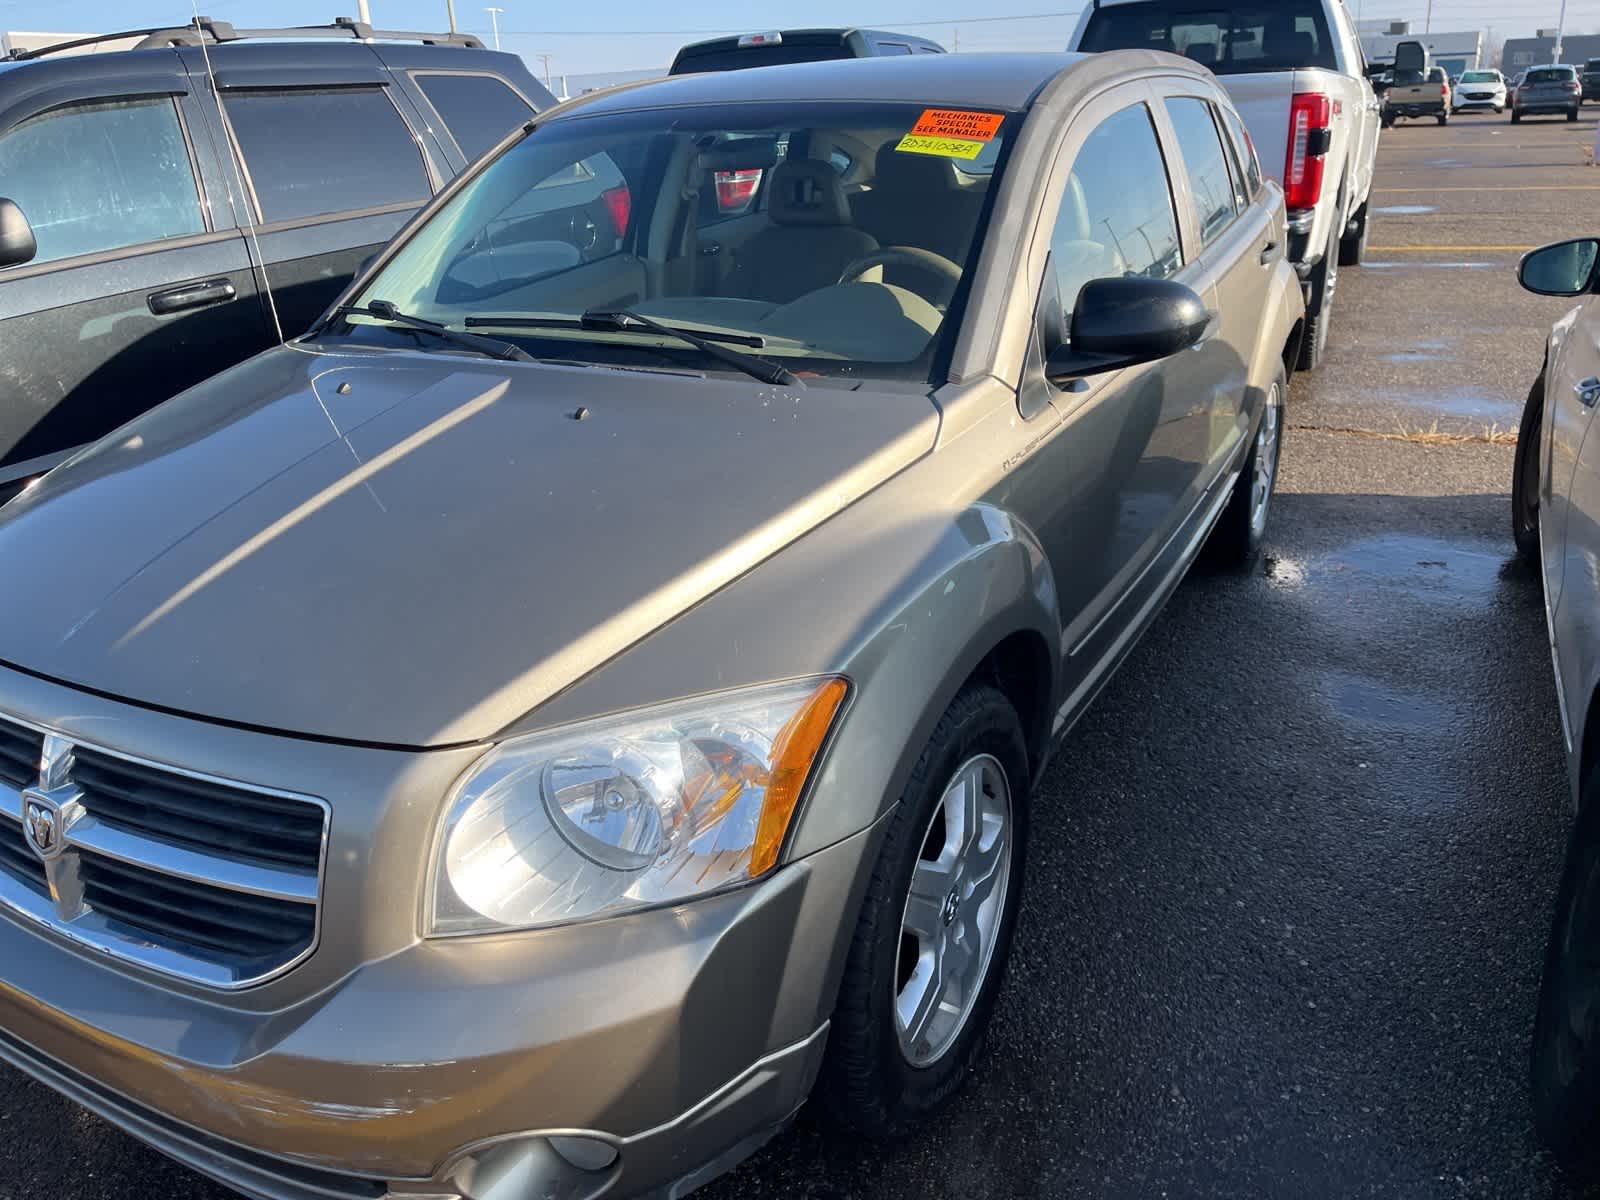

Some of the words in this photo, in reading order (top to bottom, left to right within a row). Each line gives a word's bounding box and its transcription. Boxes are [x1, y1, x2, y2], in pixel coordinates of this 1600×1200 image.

[932, 112, 992, 122] MECHANICS
[936, 119, 977, 128] SPECIAL
[937, 127, 991, 137] MANAGER
